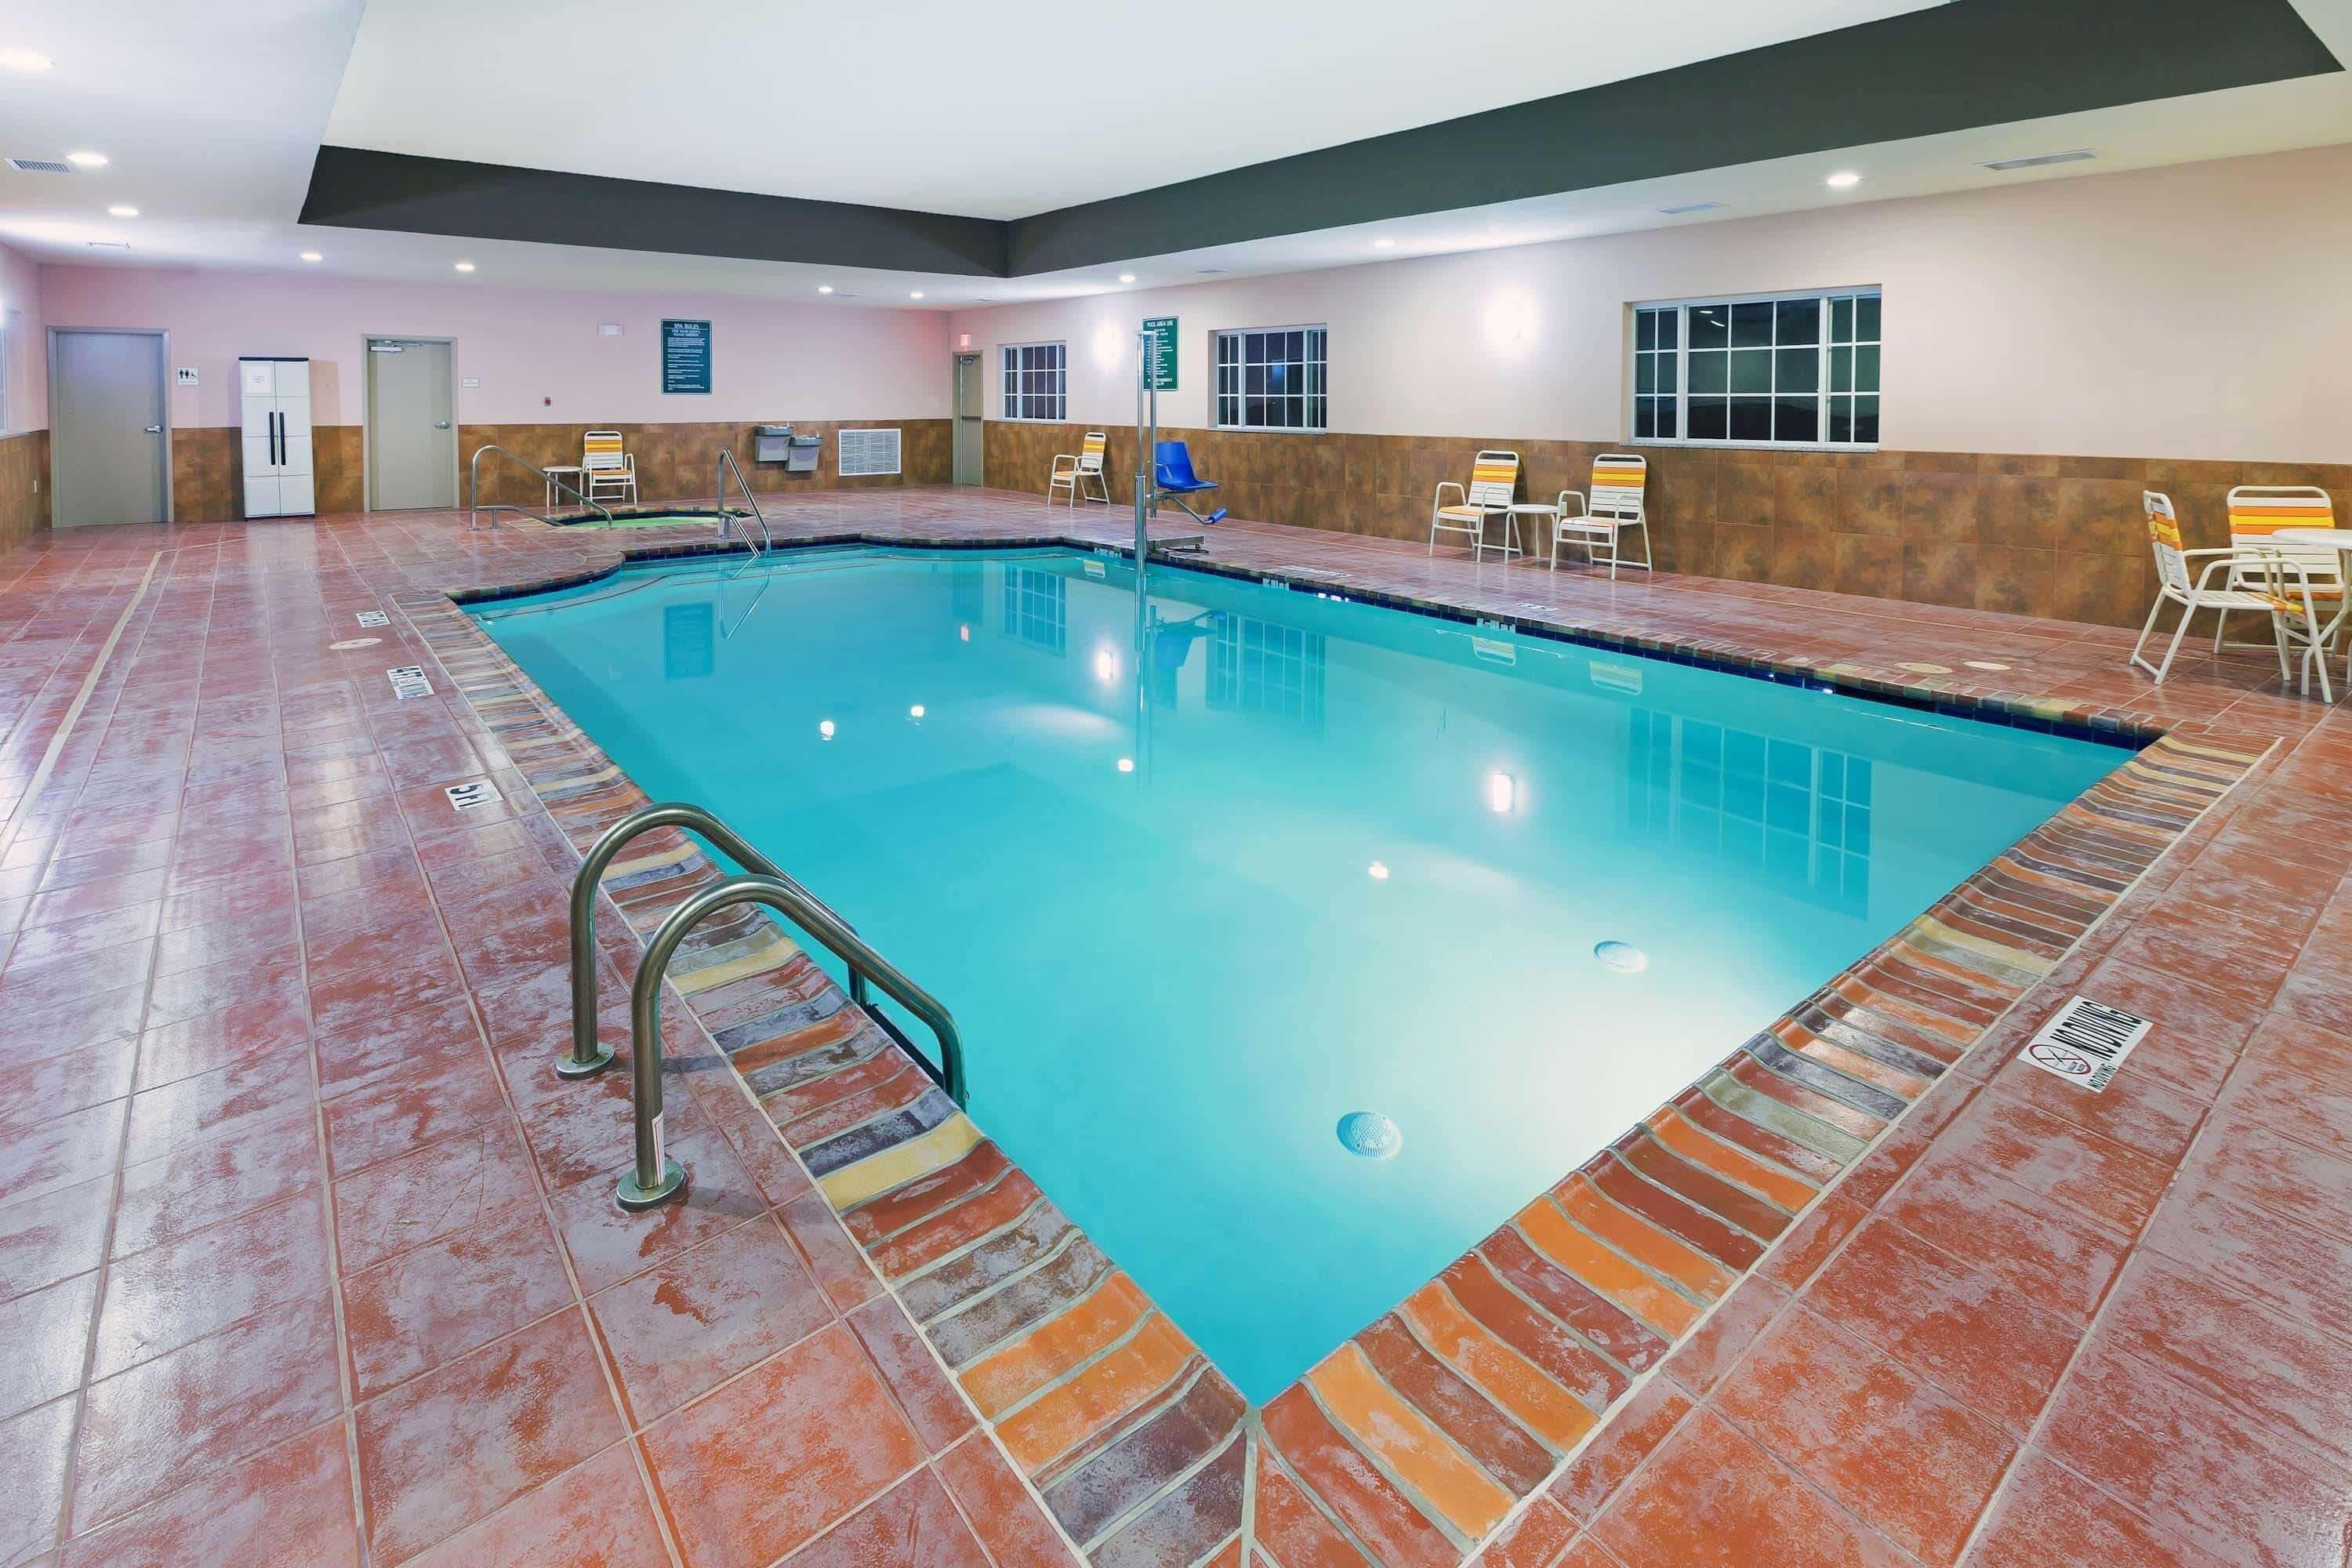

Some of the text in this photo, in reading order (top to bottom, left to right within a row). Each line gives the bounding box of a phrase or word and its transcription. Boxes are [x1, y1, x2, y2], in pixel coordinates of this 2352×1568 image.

[2049, 1000, 2143, 1062] NO DIVING
[2086, 1063, 2117, 1091] NO DIVING
